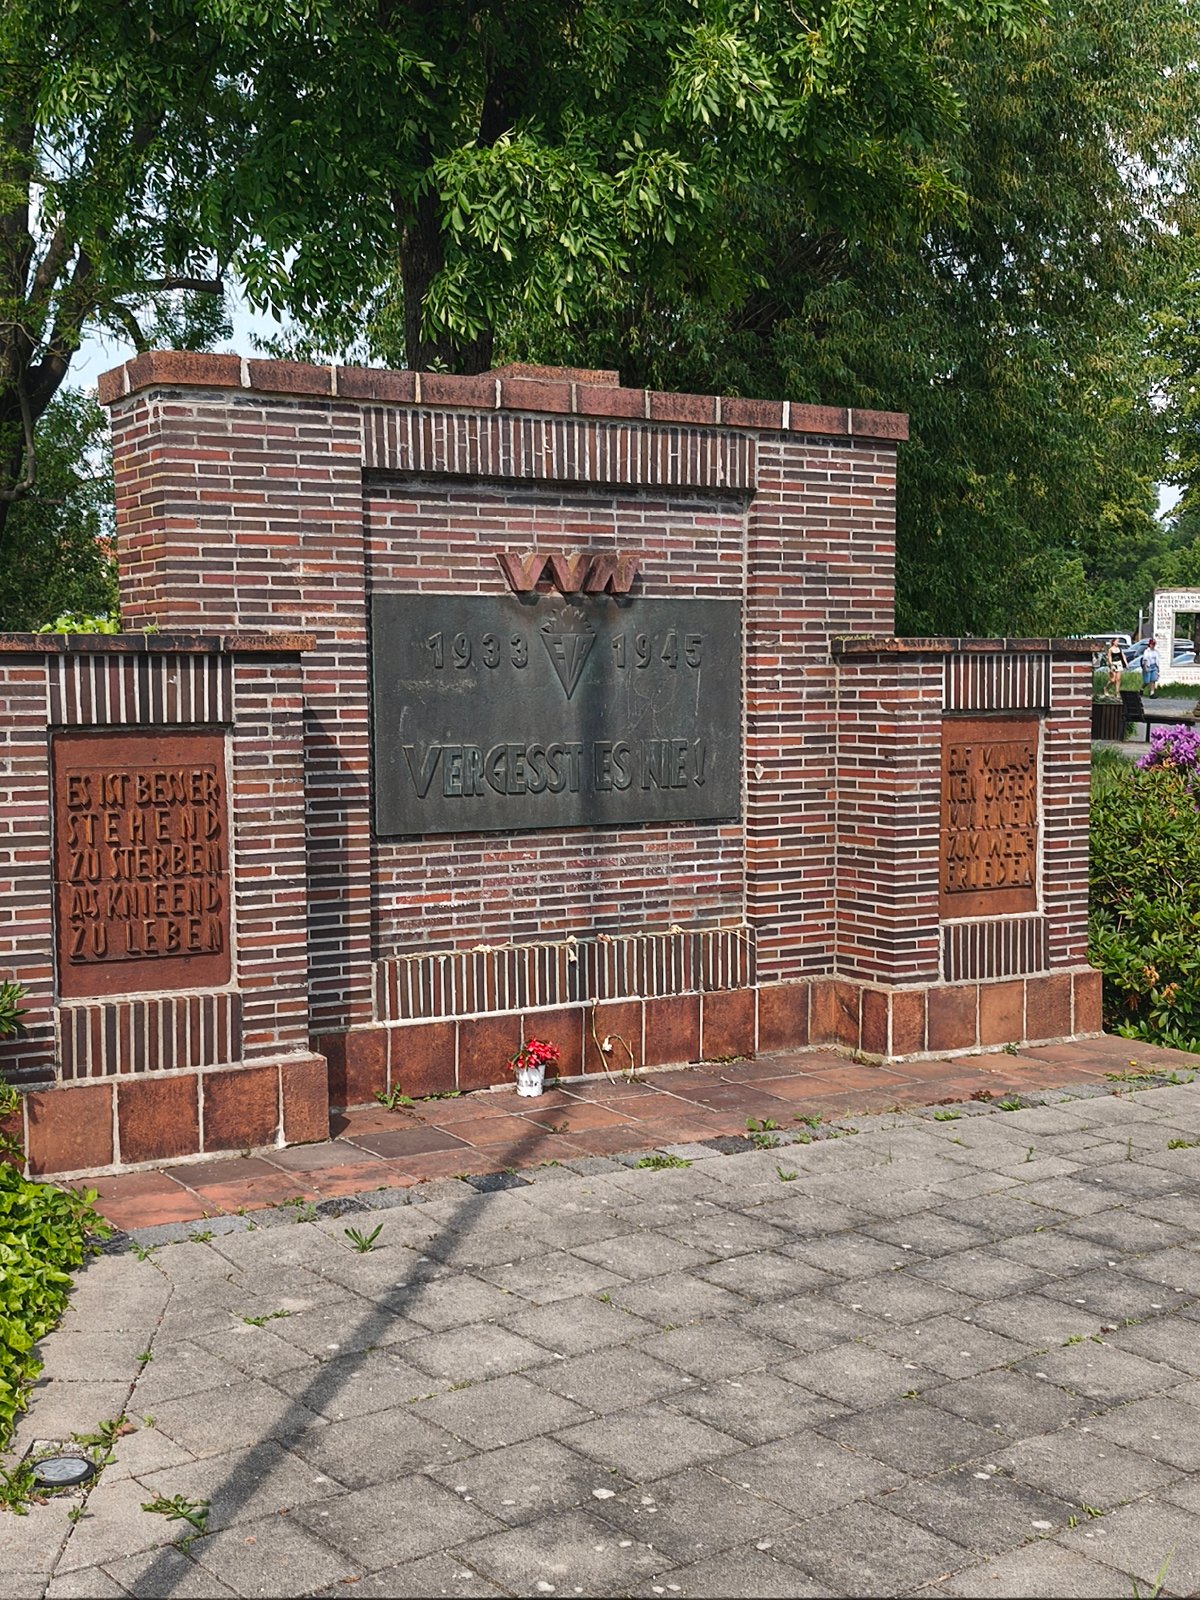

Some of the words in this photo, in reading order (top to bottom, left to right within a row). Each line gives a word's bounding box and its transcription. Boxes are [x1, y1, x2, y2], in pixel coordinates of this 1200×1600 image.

[426, 631, 528, 669] 1933
[611, 633, 702, 669] 1945
[66, 773, 91, 807] ES
[99, 770, 130, 805] IST
[135, 769, 219, 806] BESSER
[402, 741, 583, 798] VERGESST
[594, 740, 632, 792] ES
[984, 773, 1036, 802] OPFER
[67, 807, 222, 846] STEHEND
[70, 847, 101, 883] ZU
[110, 841, 222, 880] STERBEN
[946, 833, 982, 862] ZUM
[946, 858, 1035, 889] FRIEDEN
[70, 886, 101, 921] ALS
[107, 880, 222, 919] KNIEEND
[70, 922, 107, 957] ZU
[126, 914, 222, 953] LEBEN
